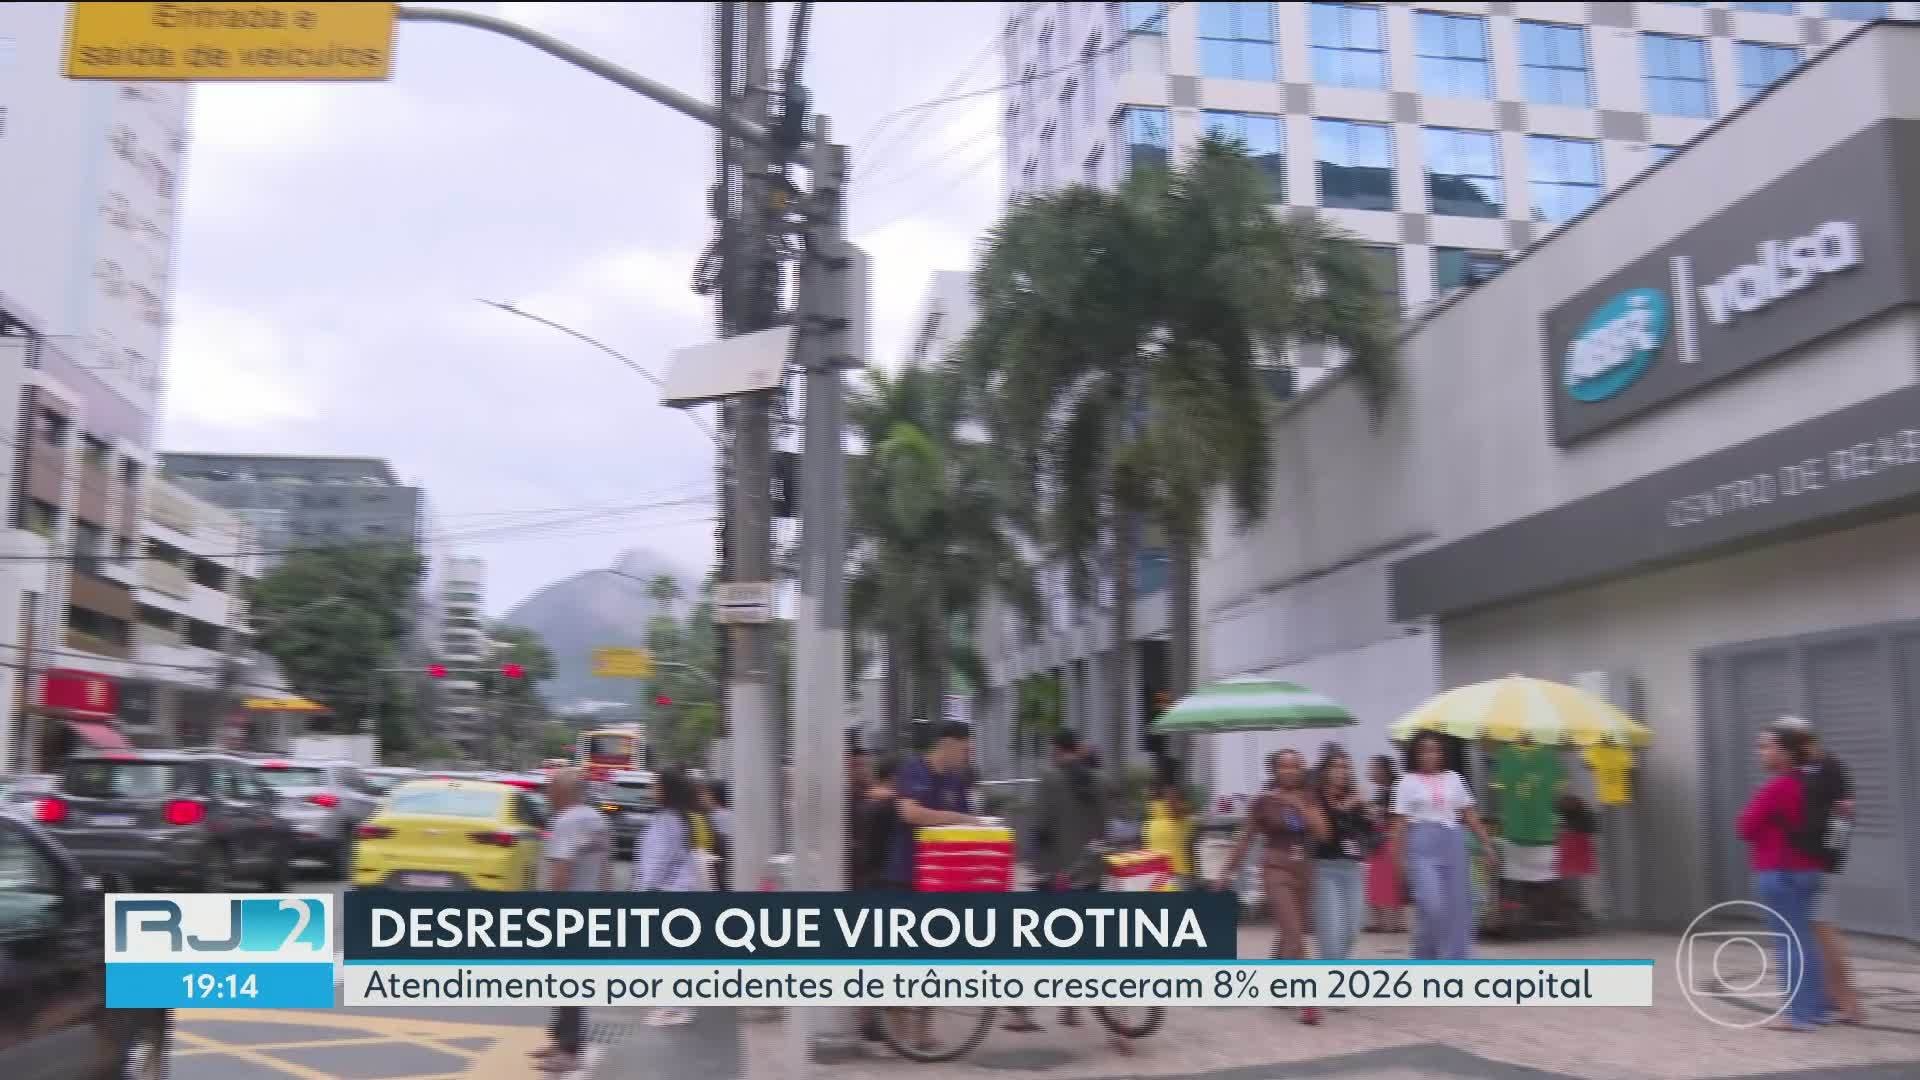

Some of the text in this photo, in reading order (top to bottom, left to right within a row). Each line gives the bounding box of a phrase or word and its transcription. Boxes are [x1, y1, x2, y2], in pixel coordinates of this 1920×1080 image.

[152, 4, 318, 29] Entrada e
[183, 43, 232, 68] de
[1664, 472, 1777, 528] CENTRO
[1778, 457, 1829, 497] DE
